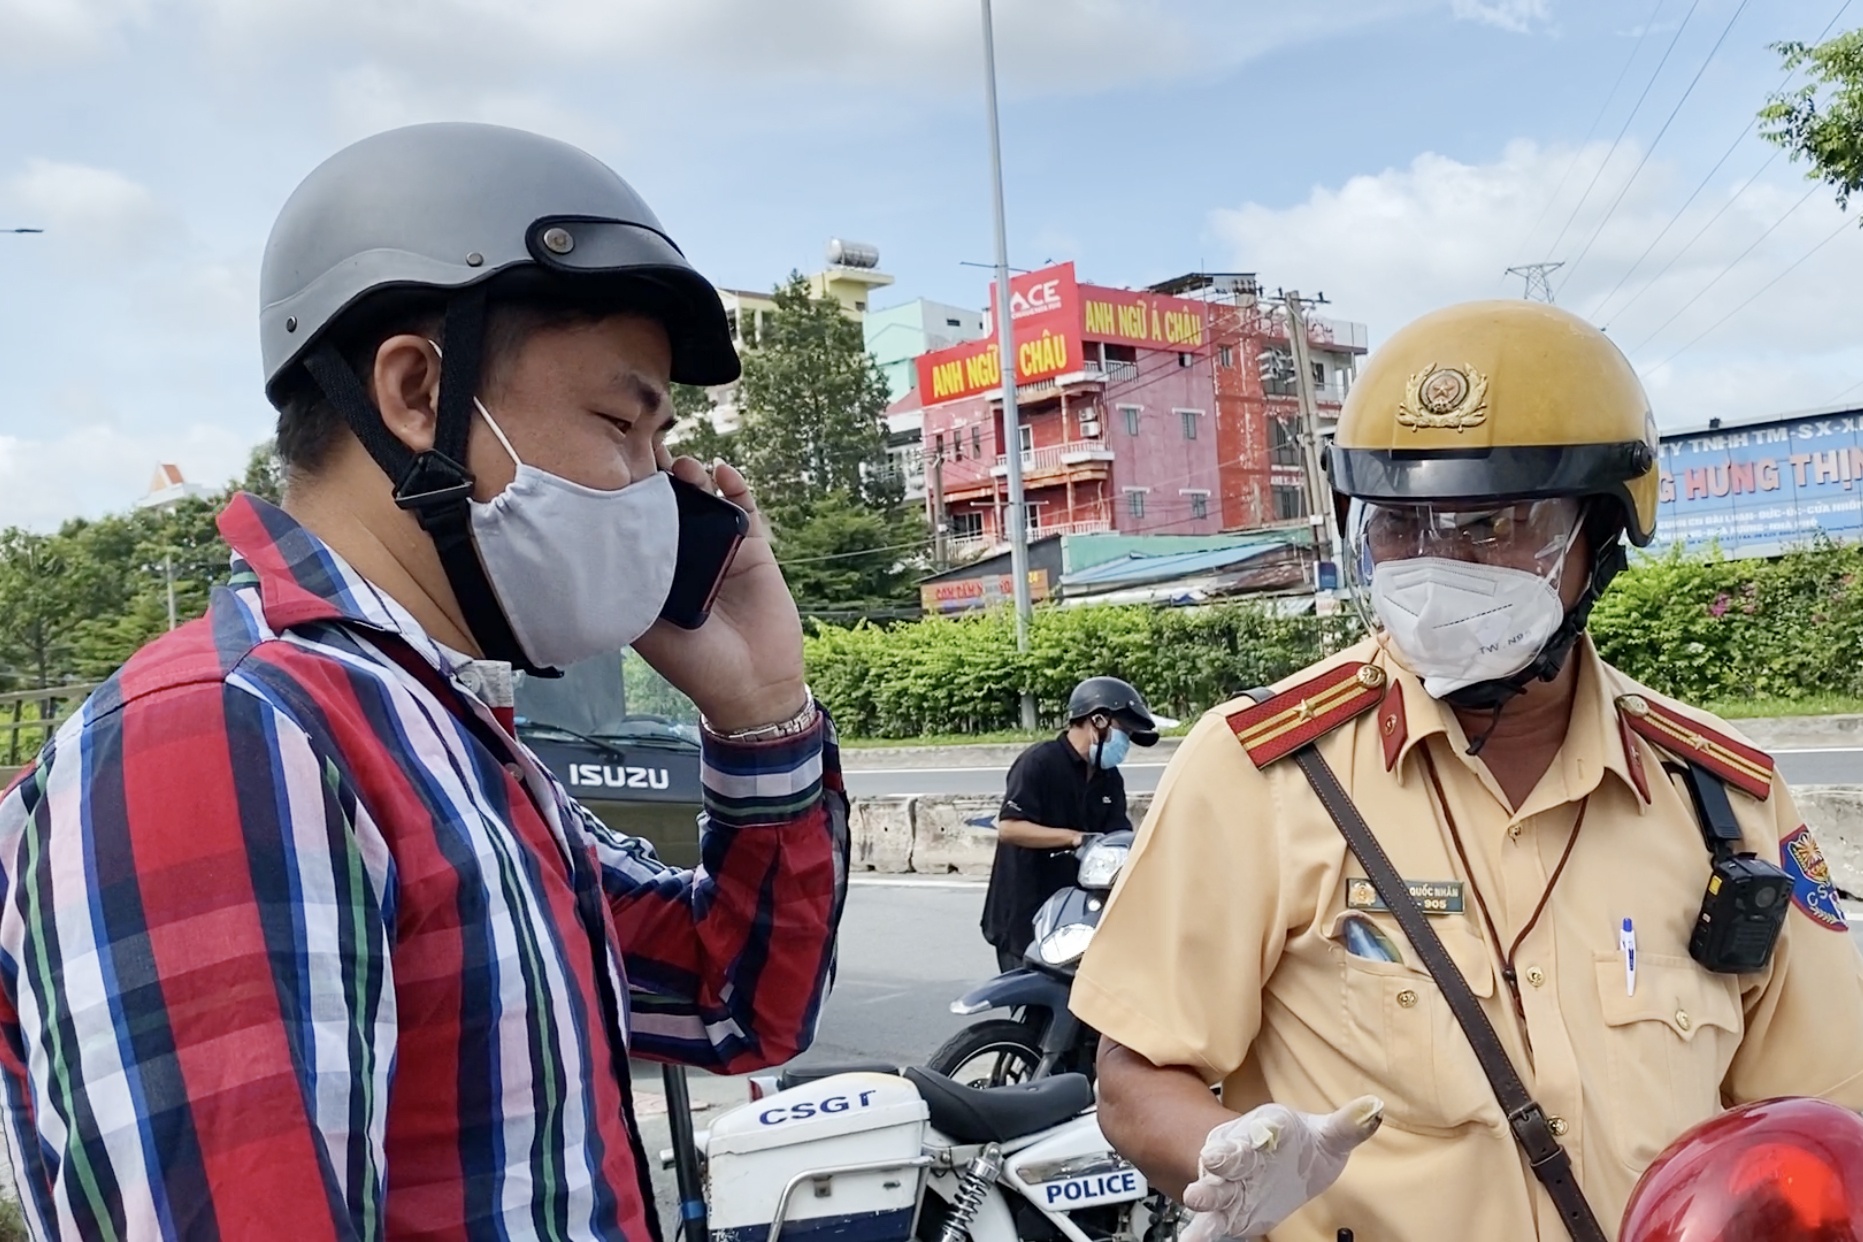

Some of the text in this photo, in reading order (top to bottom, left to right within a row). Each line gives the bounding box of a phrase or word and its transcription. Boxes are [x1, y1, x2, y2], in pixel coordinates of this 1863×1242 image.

[1010, 279, 1061, 312] ACE
[1085, 300, 1115, 335] ANH
[1118, 300, 1147, 339] NGỮ
[1151, 301, 1162, 341] Á
[1164, 305, 1202, 346] CHÂU
[932, 329, 1067, 398] ANH NGỮ CHÂU
[1689, 433, 1750, 454] TNHH
[1686, 458, 1780, 501] HƯNG
[569, 763, 670, 790] ISUZU
[1409, 883, 1433, 898] QUỐC
[1046, 1172, 1136, 1204] POLICE
